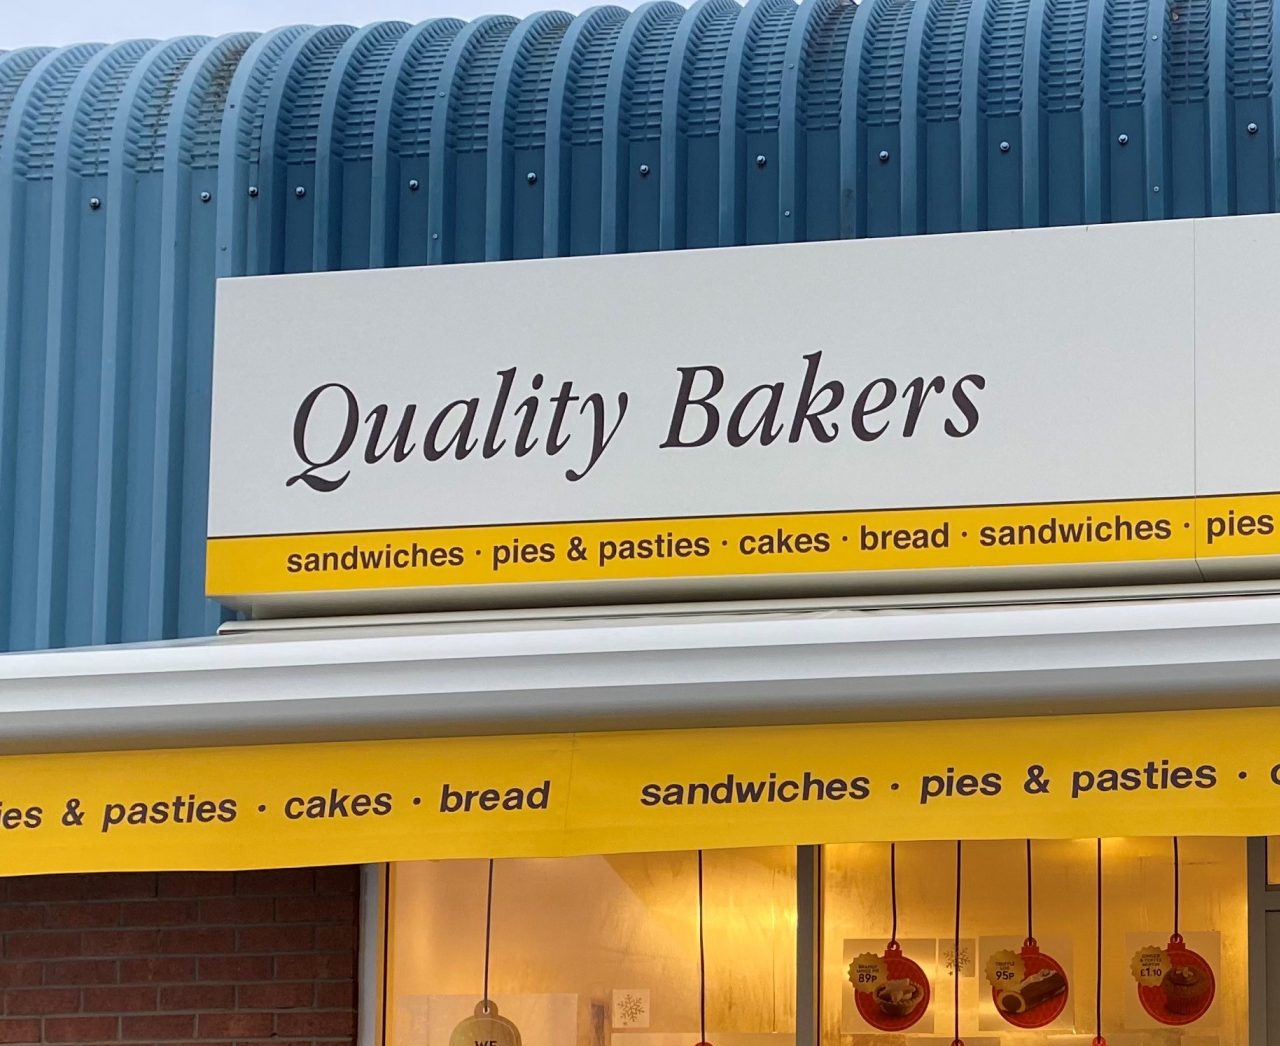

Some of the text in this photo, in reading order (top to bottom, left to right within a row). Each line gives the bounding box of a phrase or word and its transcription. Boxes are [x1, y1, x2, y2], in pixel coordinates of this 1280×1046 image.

[286, 351, 985, 492] Quality Bakers
[288, 543, 464, 573] sandwiches
[494, 539, 556, 571] pies
[567, 537, 588, 562] &
[600, 533, 710, 567] pasties
[740, 530, 831, 556] cakes
[861, 522, 949, 552] bread
[980, 516, 1172, 547] sandwiches
[1208, 511, 1274, 546] pies
[62, 799, 85, 827] &
[103, 795, 237, 834] pasties
[285, 789, 392, 821] cakes
[440, 781, 551, 814] bread
[641, 772, 870, 807] sandwiches
[921, 768, 1002, 806] pies
[1024, 765, 1050, 795] &
[1072, 760, 1217, 799] pasties
